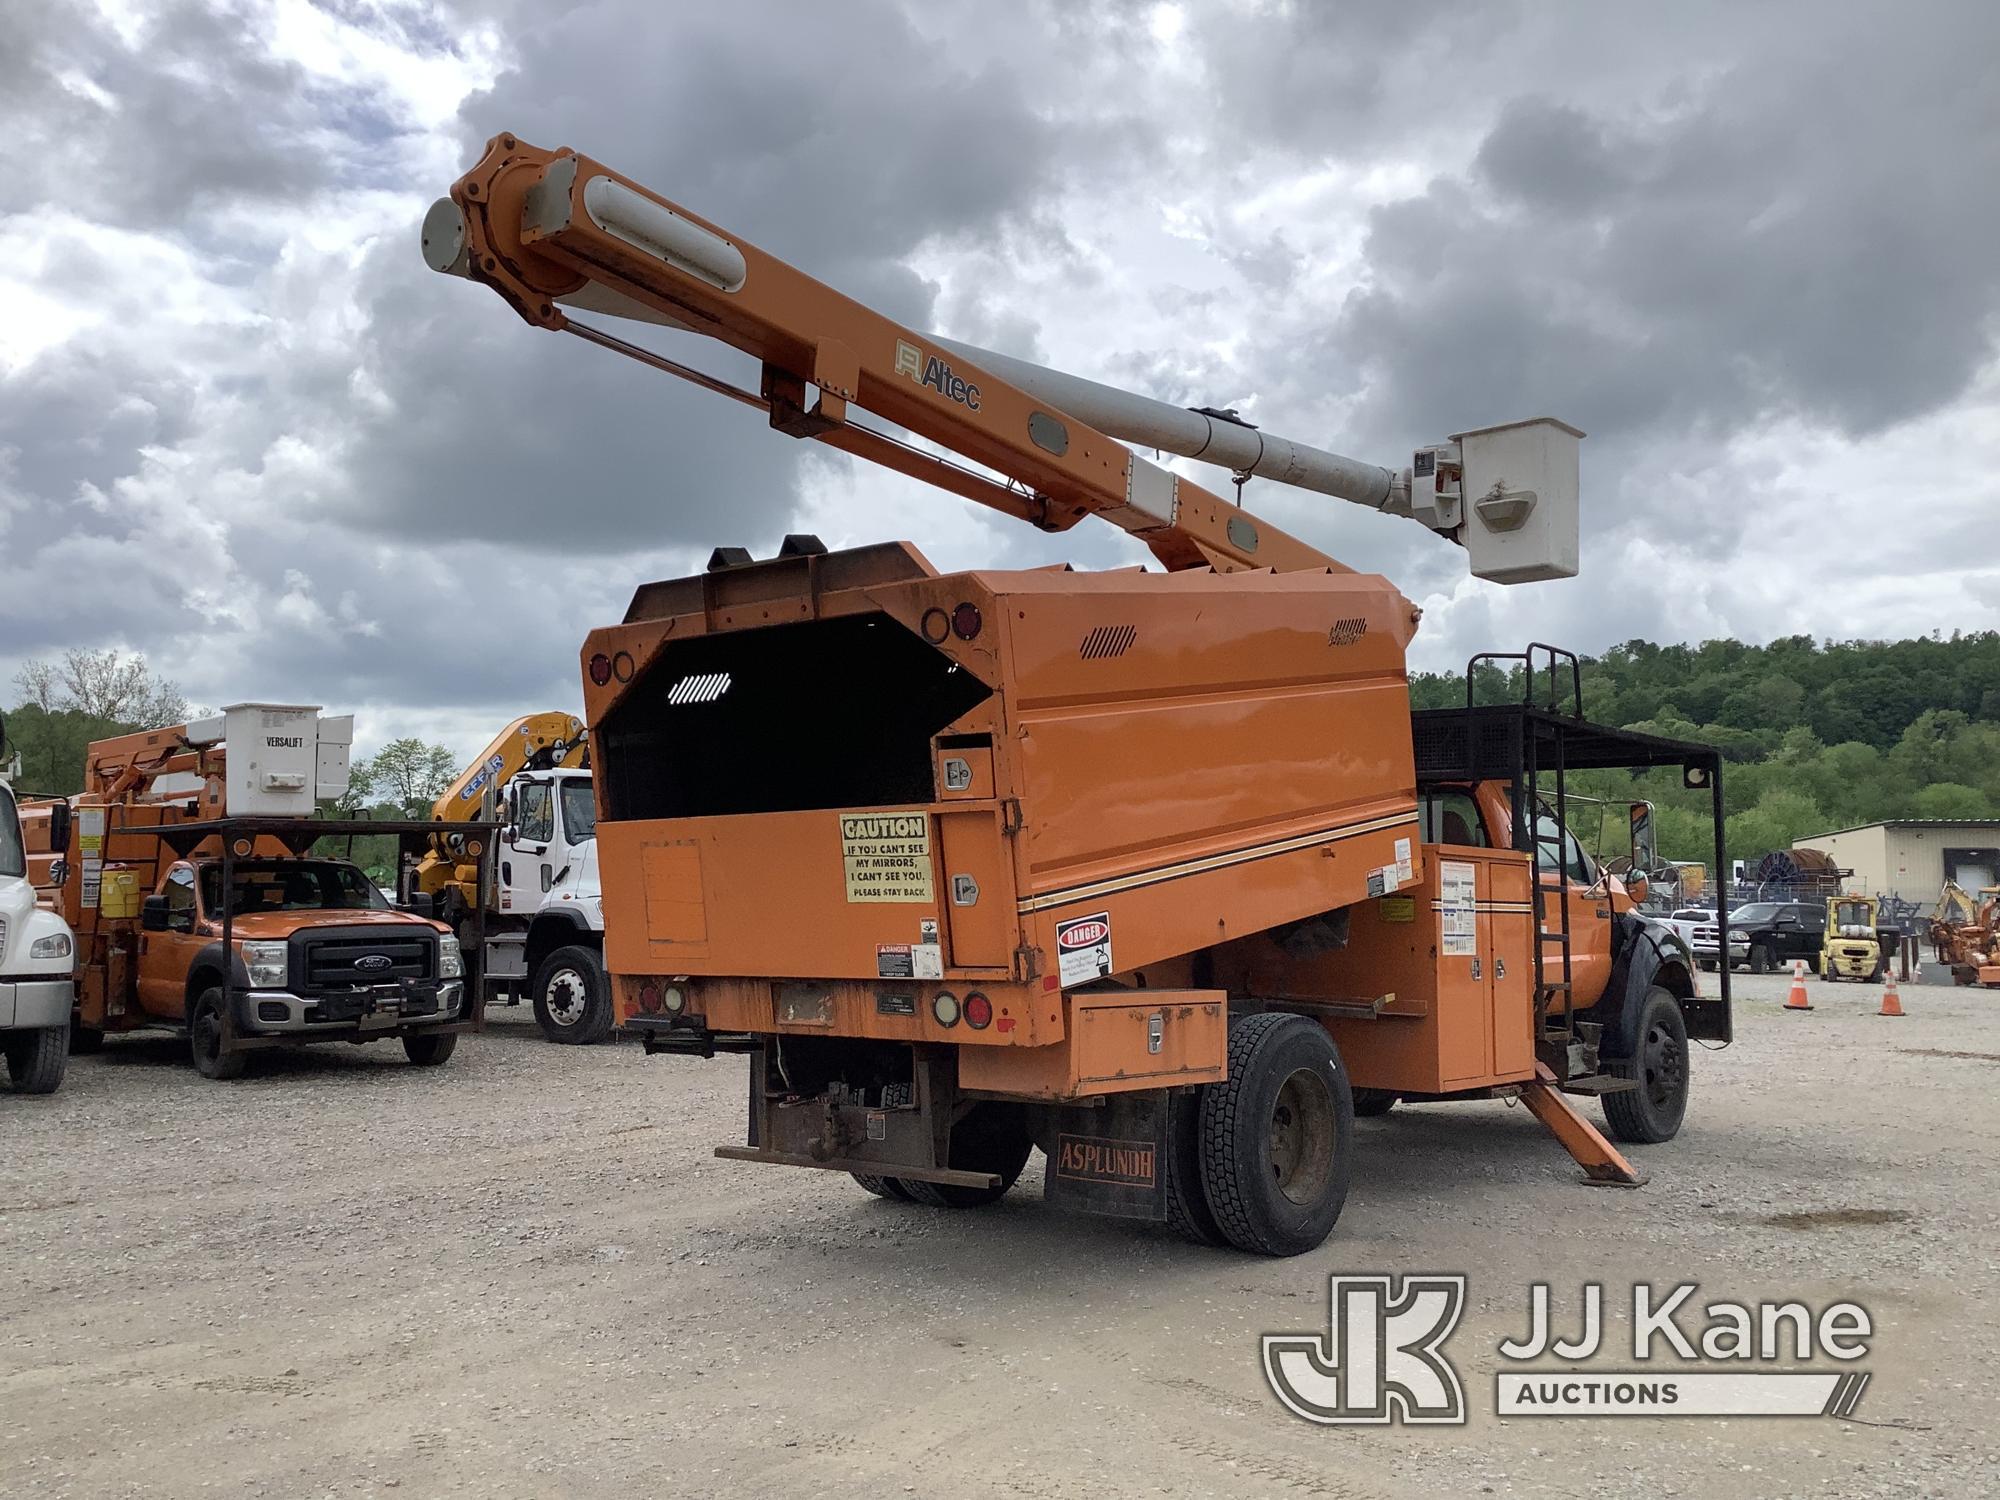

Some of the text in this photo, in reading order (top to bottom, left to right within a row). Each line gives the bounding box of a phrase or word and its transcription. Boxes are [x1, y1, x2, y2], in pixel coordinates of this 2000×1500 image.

[922, 356, 981, 411] Altec
[266, 736, 303, 748] VERSALIFT
[463, 755, 503, 798] EFFR
[844, 817, 924, 839] CAUTION
[847, 844, 924, 855] IF YOU CAN'T SEE
[856, 858, 917, 869] MY MIRRORS,
[857, 872, 882, 881] CAN'T
[885, 872, 900, 881] SEE
[854, 888, 925, 897] PLEASE STAY BACK
[1067, 924, 1101, 945] DANGER
[885, 945, 908, 953] DANGER
[1060, 1142, 1153, 1178] ASPLUNDH
